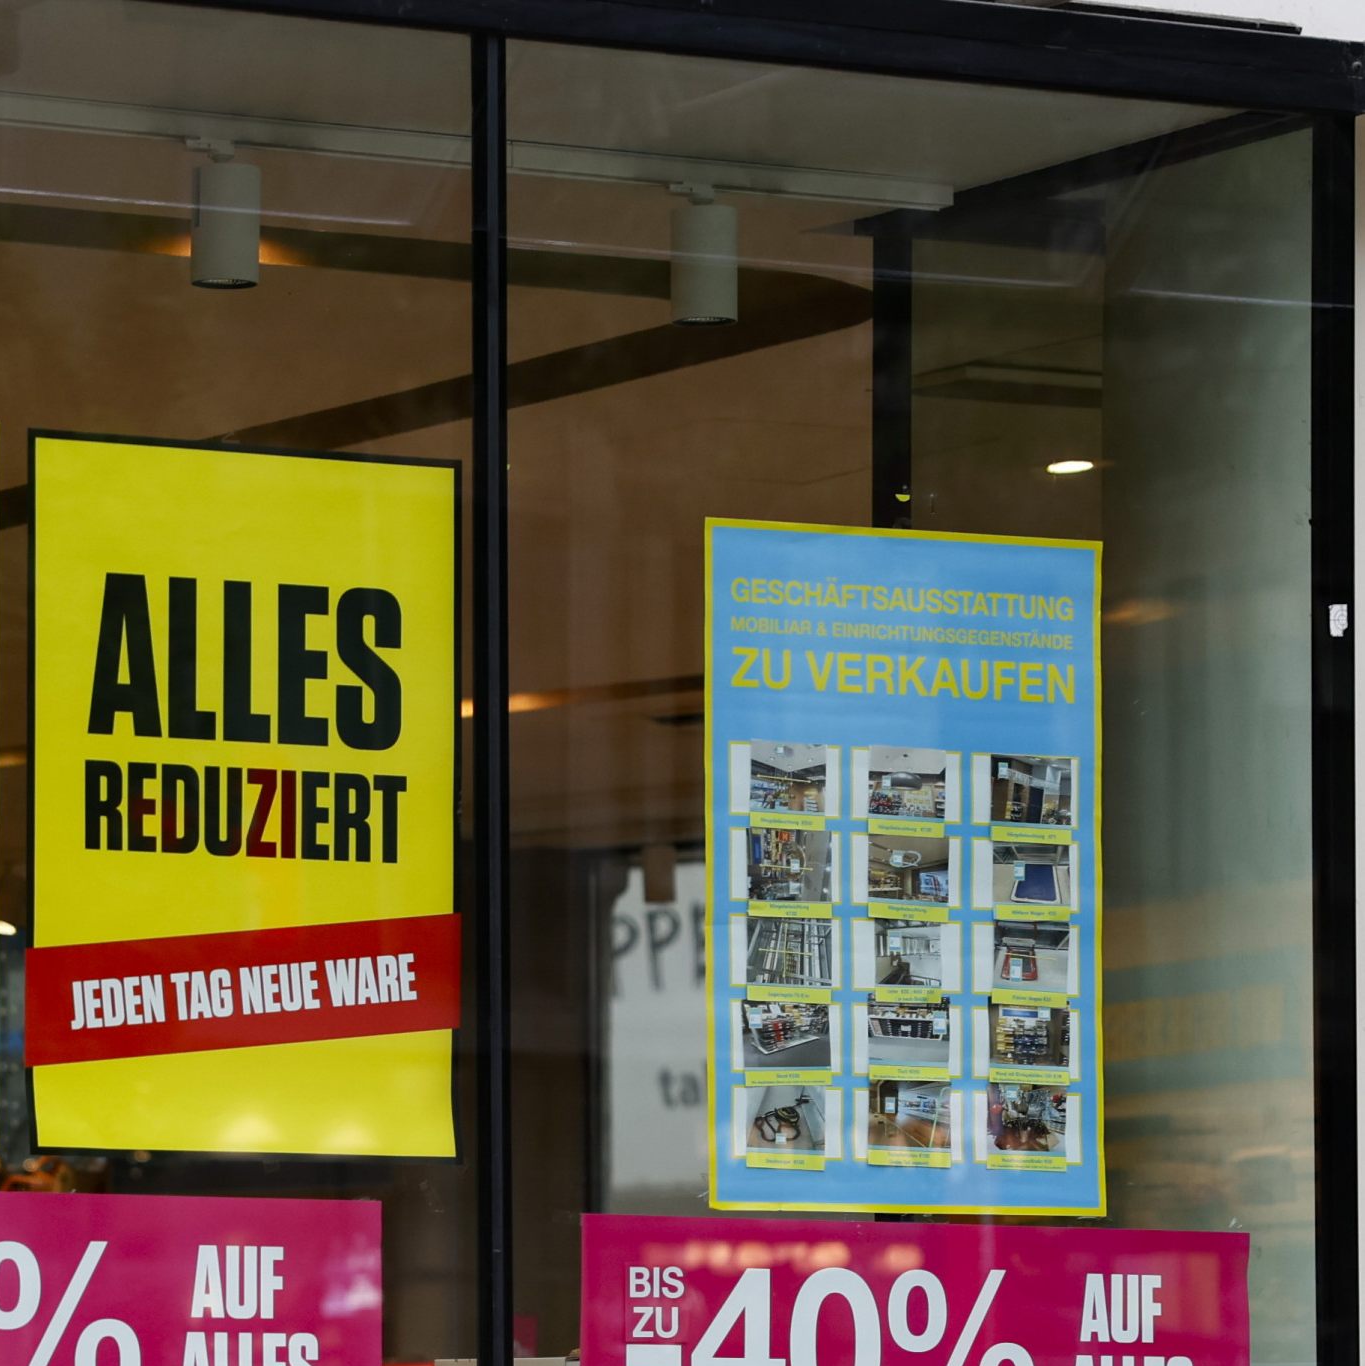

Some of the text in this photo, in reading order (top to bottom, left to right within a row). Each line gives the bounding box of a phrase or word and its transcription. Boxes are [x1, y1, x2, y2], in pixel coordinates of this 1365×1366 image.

[731, 576, 1074, 620] GESCHÄFTSAUSSTATTUNG
[88, 573, 401, 750] ALLES
[731, 616, 1073, 650] MOBILIAR & EINRICHTUNGSGEGENSTÄNDE
[731, 647, 1075, 704] ZU VERKAUFEN
[85, 760, 407, 863] REDUZIERT
[72, 954, 417, 1029] JEDEN TAG NEUE WARE
[191, 1245, 283, 1319] AUF
[630, 1267, 684, 1298] BIS
[1081, 1274, 1161, 1343] AUF
[633, 1307, 678, 1338] ZU
